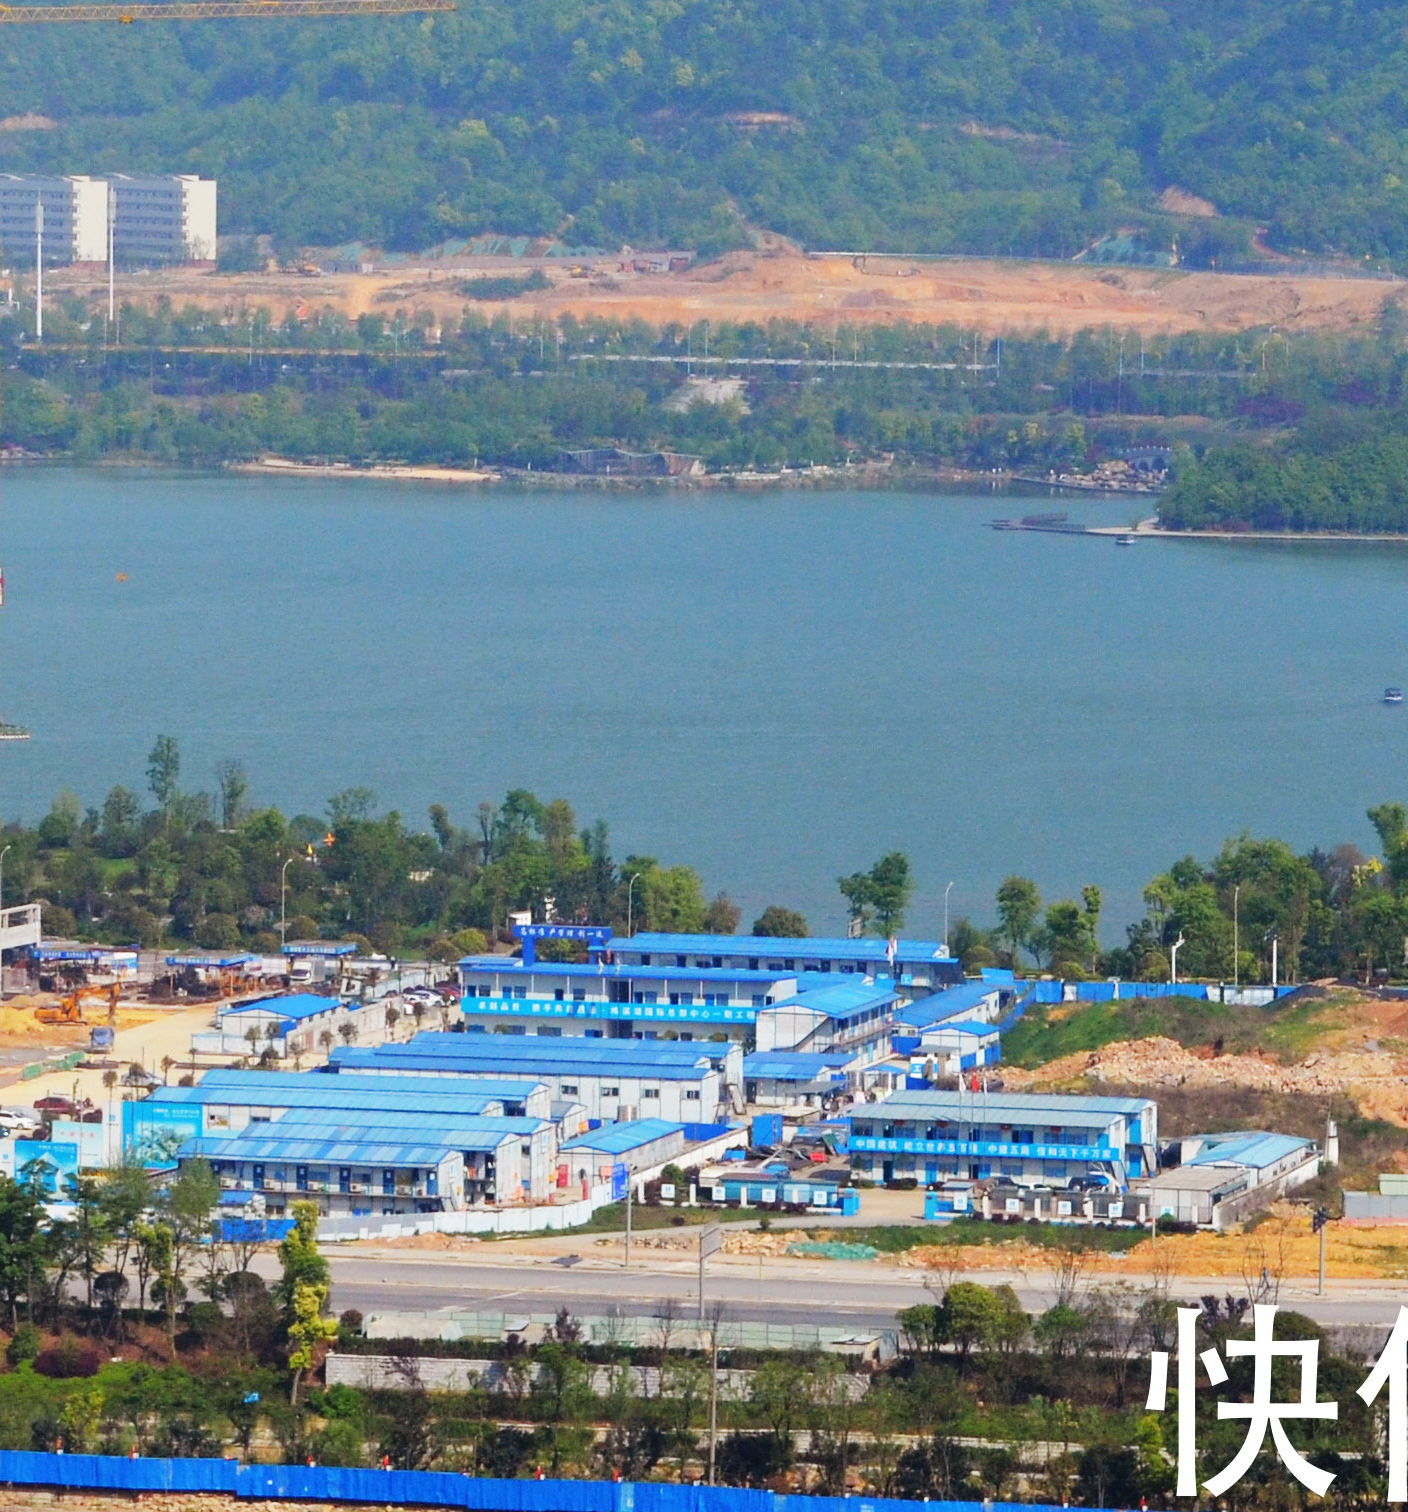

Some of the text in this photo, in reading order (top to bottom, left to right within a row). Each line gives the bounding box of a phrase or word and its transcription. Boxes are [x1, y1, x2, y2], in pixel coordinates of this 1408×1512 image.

[855, 1139, 897, 1150] 中国建筑
[987, 1144, 1030, 1156] 中建五局
